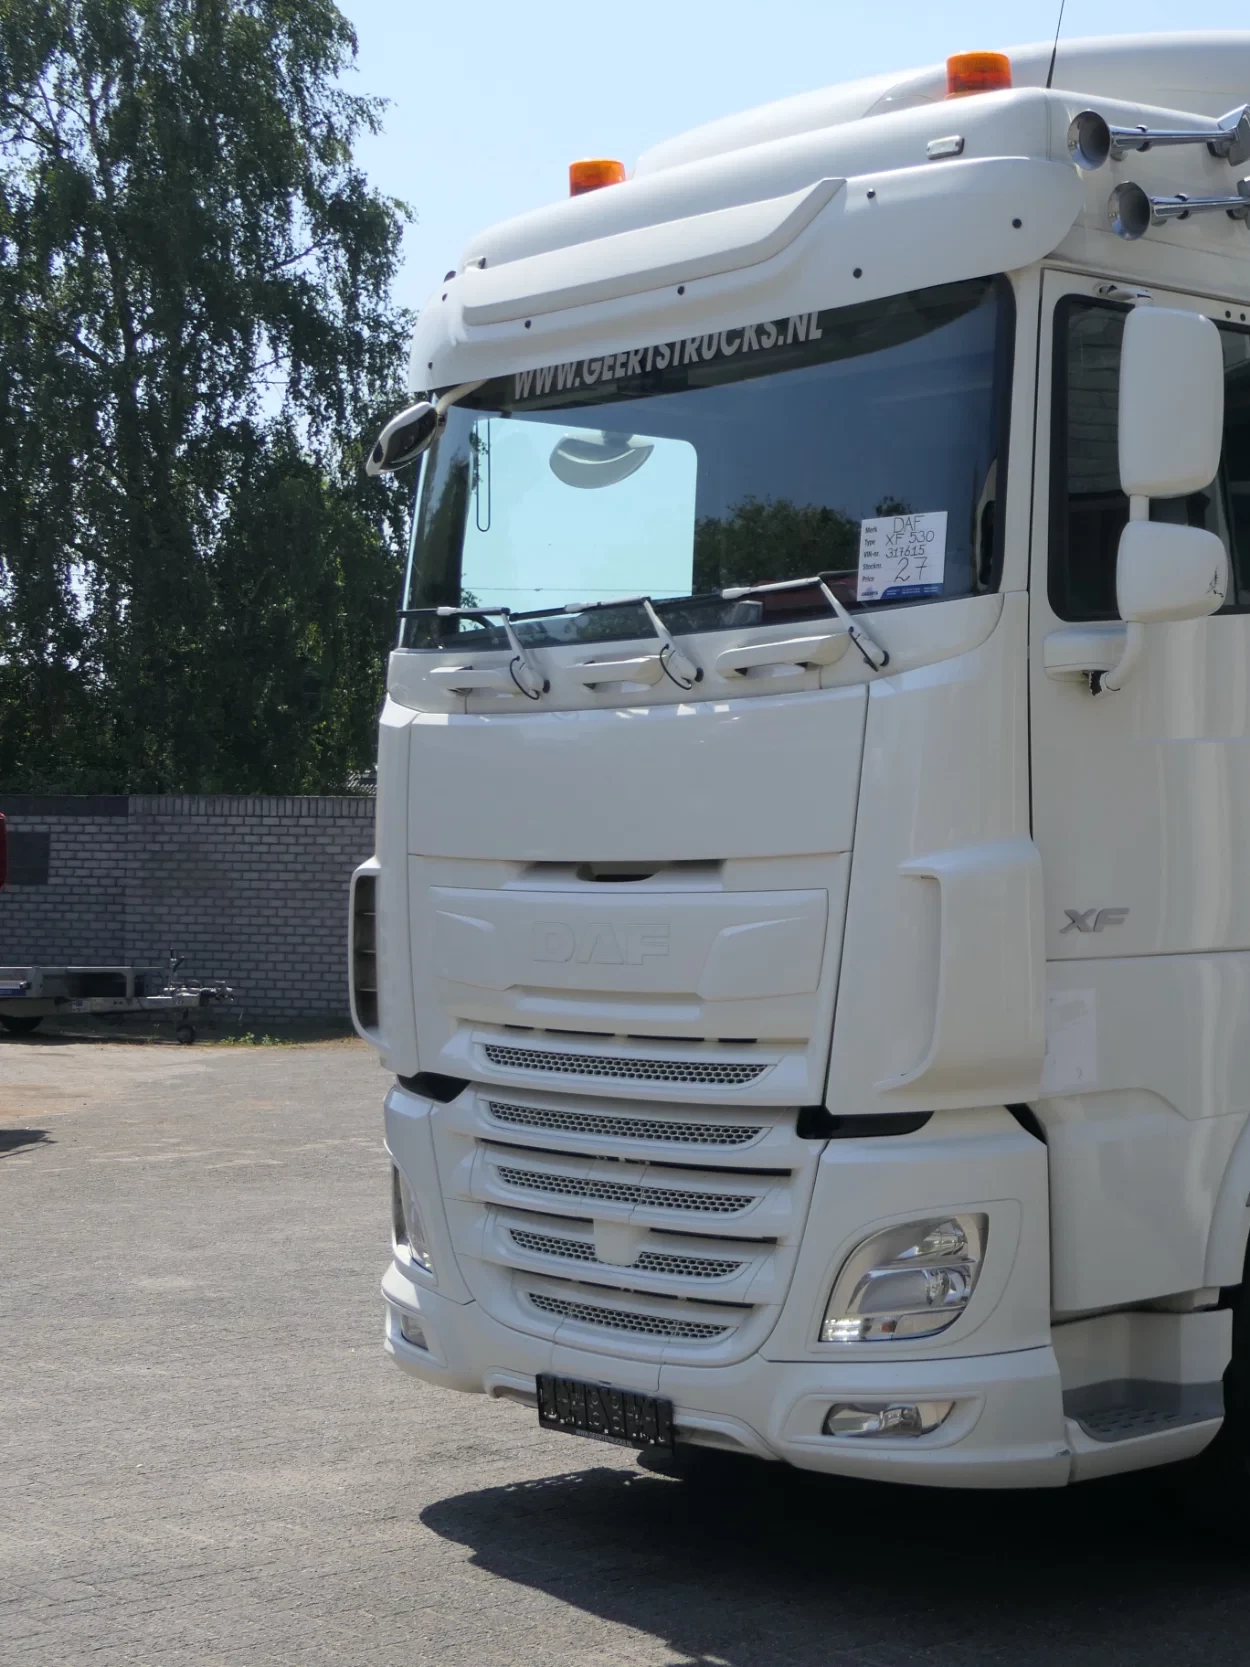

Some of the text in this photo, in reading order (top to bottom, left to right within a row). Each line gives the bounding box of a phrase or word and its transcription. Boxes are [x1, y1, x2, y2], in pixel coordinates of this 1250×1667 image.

[514, 312, 823, 400] WWW.GEERTSTRUCKS.NL
[893, 515, 925, 533] DAF
[885, 530, 935, 546] XF 530
[894, 556, 928, 582] 27
[1059, 908, 1130, 933] XF
[532, 921, 670, 966] DAF
